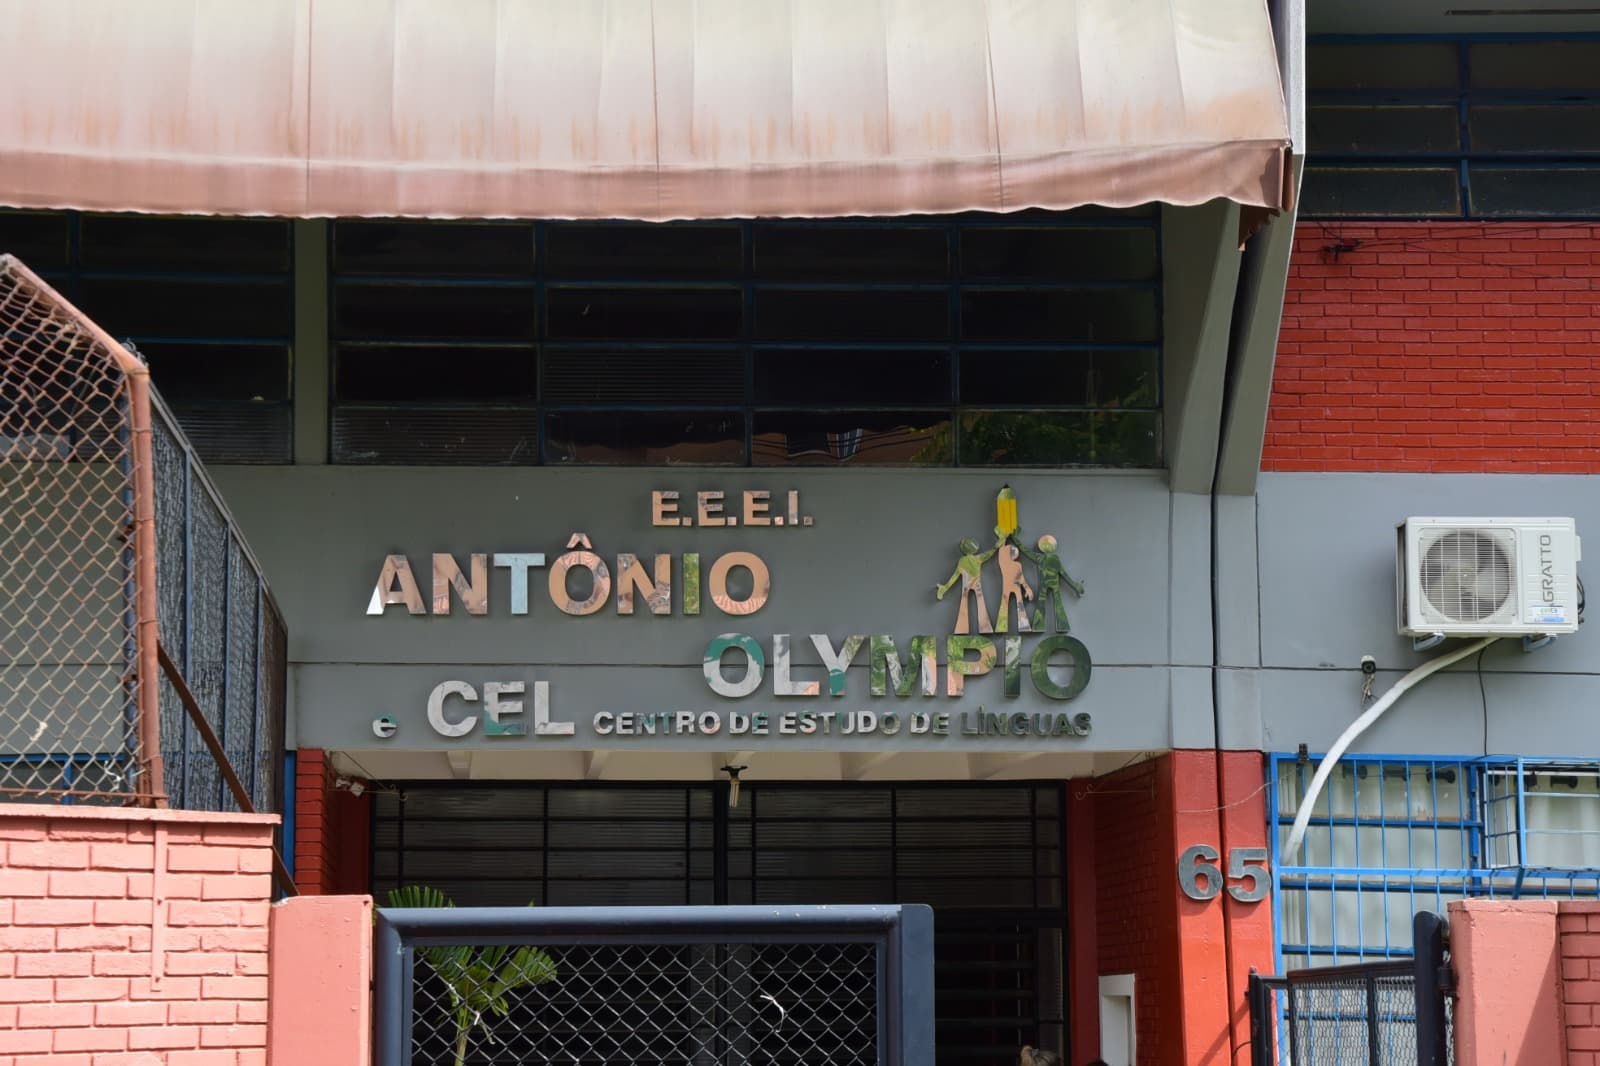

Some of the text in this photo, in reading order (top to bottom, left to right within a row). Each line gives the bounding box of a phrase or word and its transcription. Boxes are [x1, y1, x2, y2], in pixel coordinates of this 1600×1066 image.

[366, 532, 770, 616] ANTÔNIO
[703, 632, 1092, 699] OLYMPIO
[372, 680, 1092, 739] e CEL CENTRO DE ESTUDO DE LÍNGUAS
[1178, 843, 1272, 902] 65
